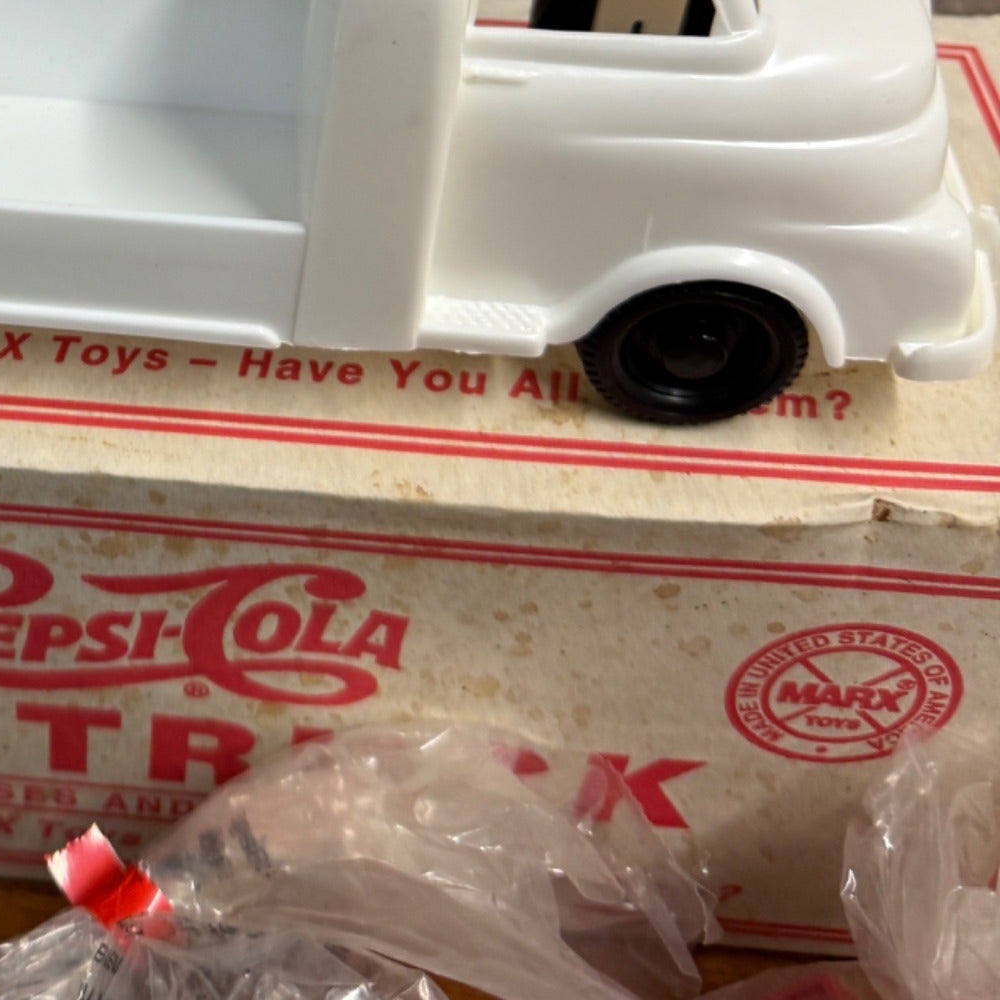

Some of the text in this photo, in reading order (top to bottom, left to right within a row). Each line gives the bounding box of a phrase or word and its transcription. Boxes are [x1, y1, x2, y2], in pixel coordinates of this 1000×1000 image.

[51, 335, 169, 375] Toys
[237, 348, 364, 386] Have
[389, 357, 487, 396] You
[508, 368, 581, 402] All
[750, 634, 830, 681] UNITED
[838, 631, 934, 664] STATES
[738, 682, 757, 698] IN
[923, 663, 950, 687] OF
[739, 701, 785, 742] MADE
[805, 714, 862, 731] TOYS
[16, 702, 708, 830] TRK
